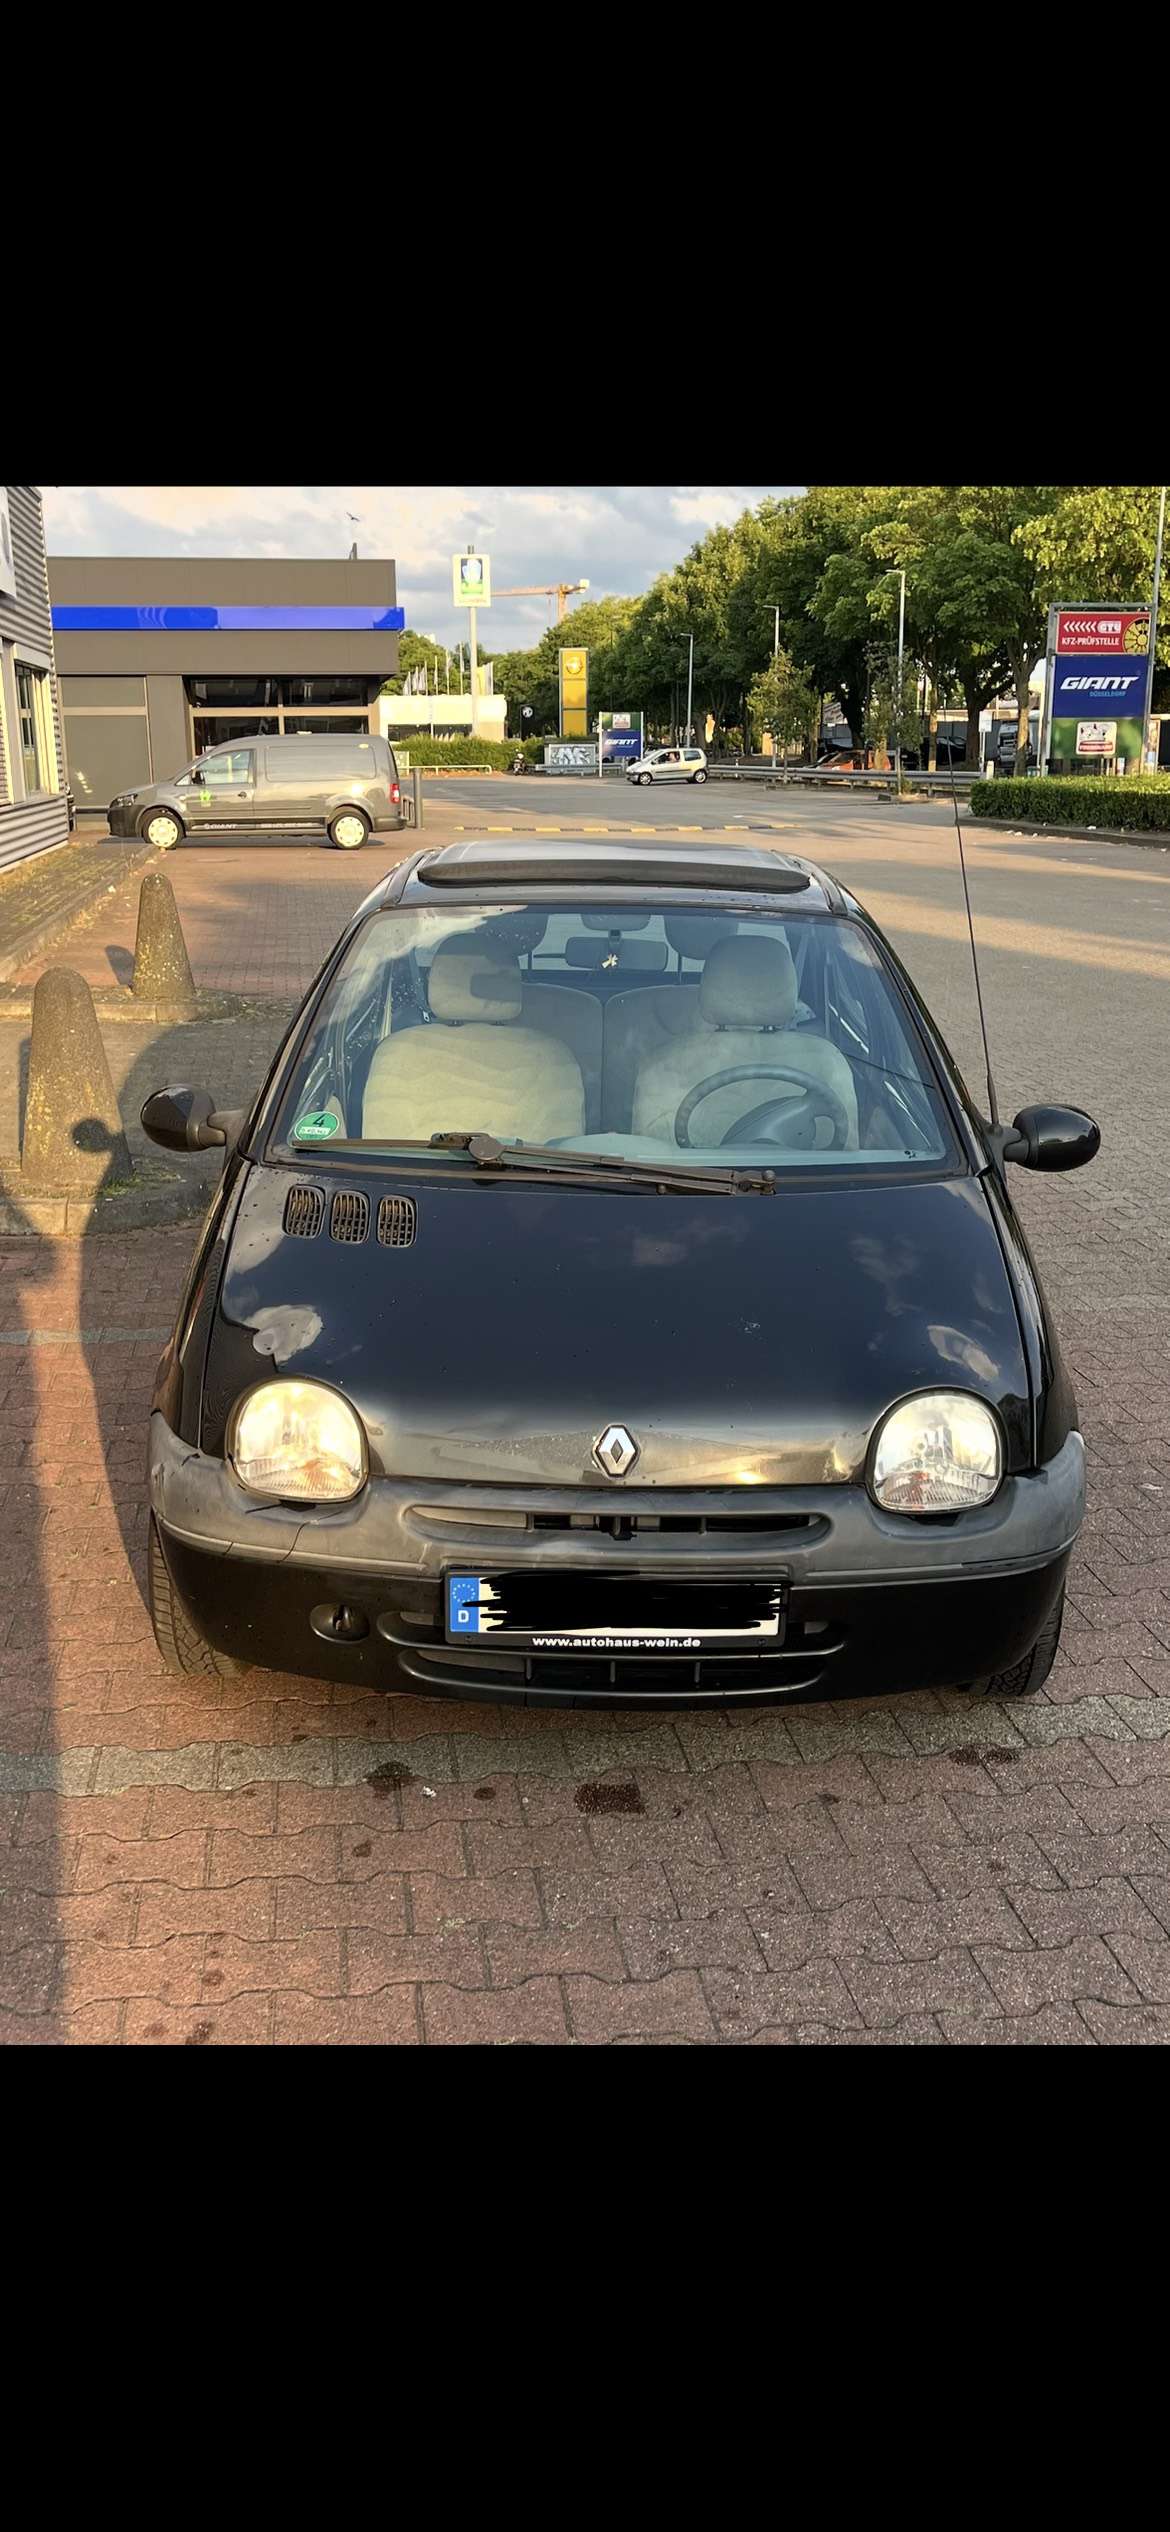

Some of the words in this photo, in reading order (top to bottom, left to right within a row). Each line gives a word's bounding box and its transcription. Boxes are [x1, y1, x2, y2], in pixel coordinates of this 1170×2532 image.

[1061, 636, 1119, 646] KFZ-PRÜFSTELLE
[1060, 676, 1139, 690] GIANT
[312, 1113, 326, 1127] 4
[458, 1610, 469, 1623] D
[532, 1637, 701, 1648] www.autohaus-wein.de
